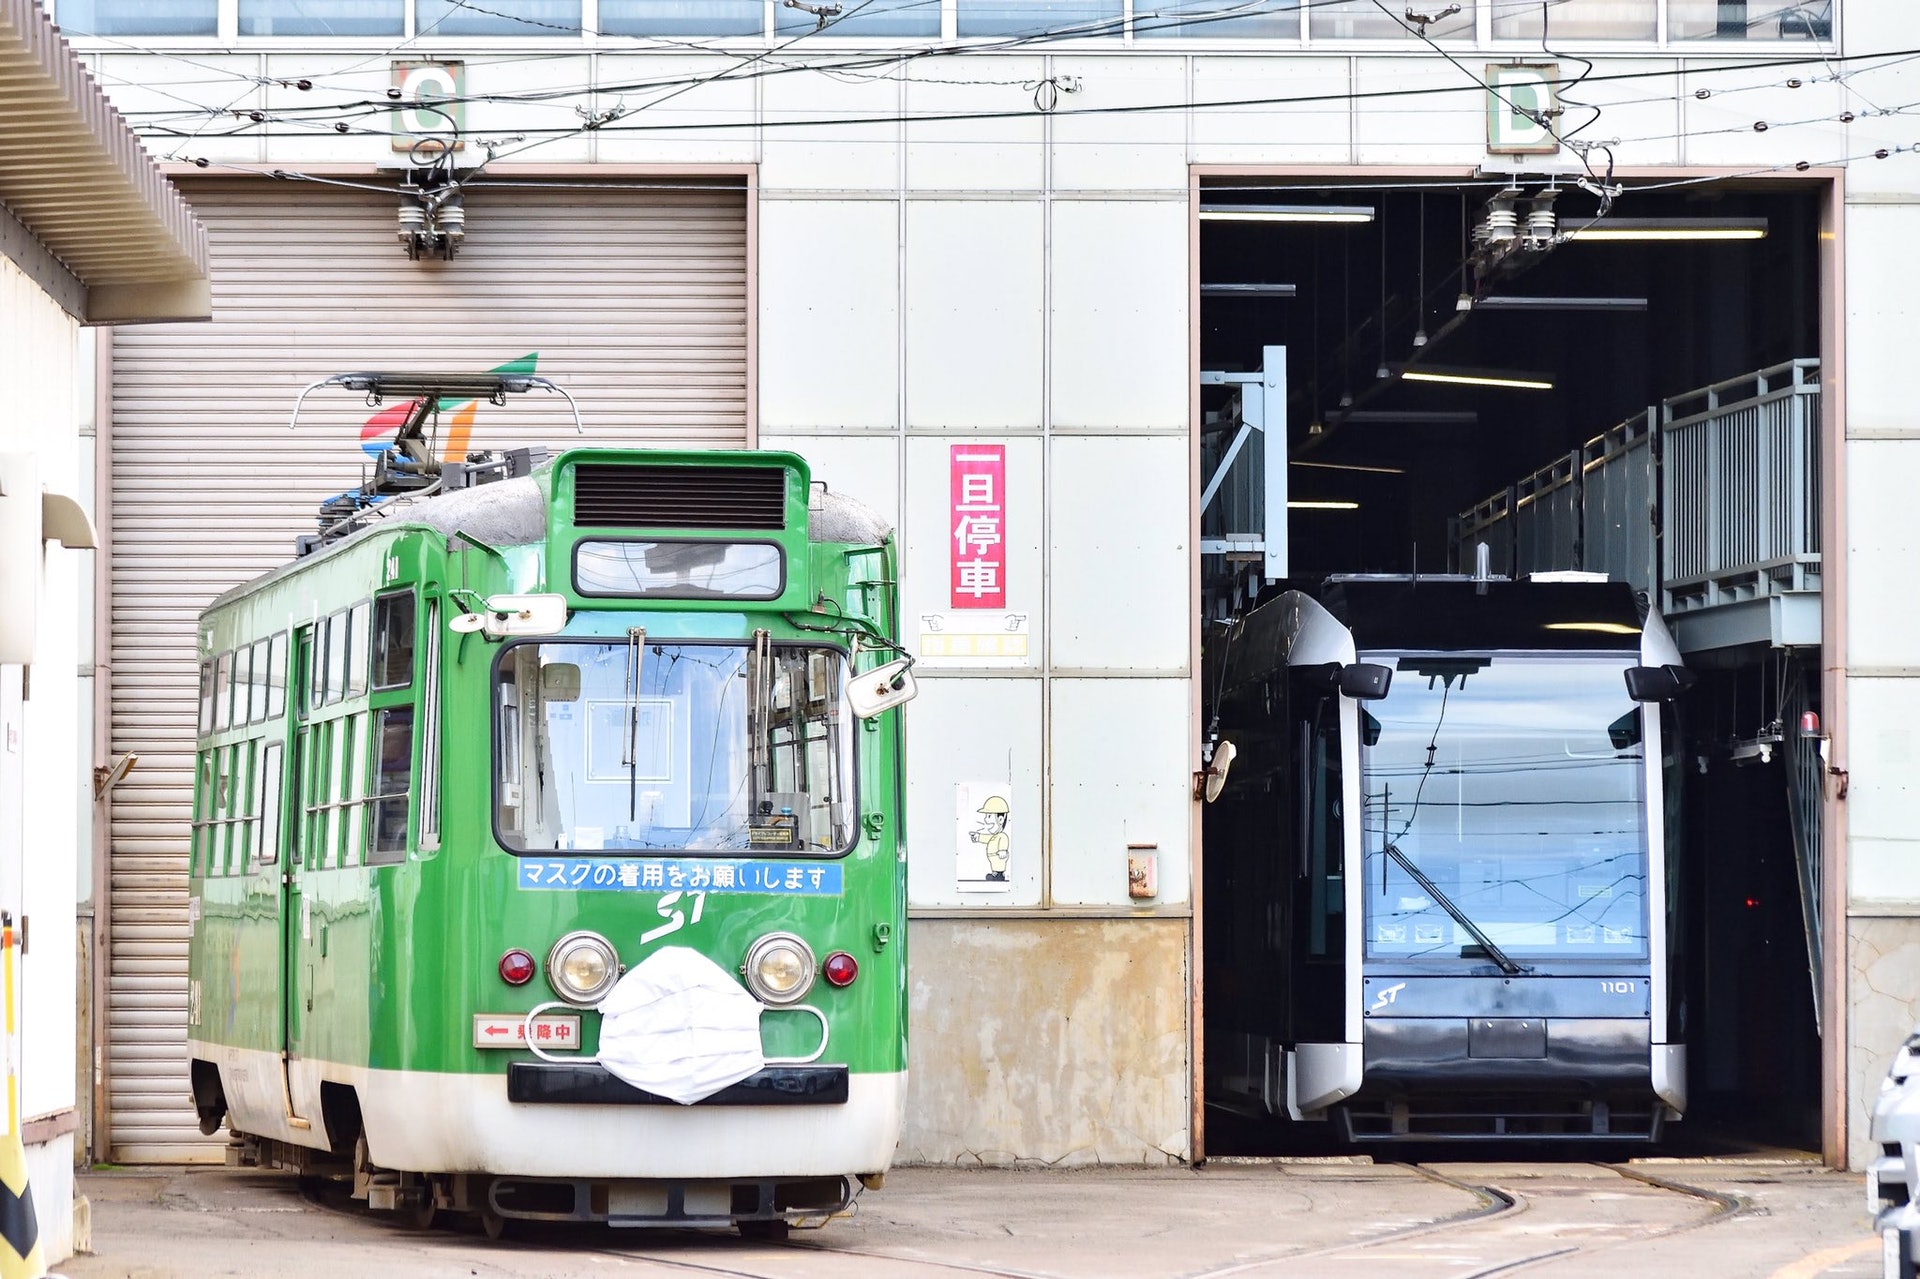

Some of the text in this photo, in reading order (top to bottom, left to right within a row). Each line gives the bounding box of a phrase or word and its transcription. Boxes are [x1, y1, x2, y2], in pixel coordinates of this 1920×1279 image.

[1499, 72, 1550, 143] D
[954, 454, 1000, 598] 一旦停車
[524, 863, 825, 889] マスクの着用をお願いします
[1372, 982, 1406, 1009] ST
[1601, 982, 1636, 993] 1101
